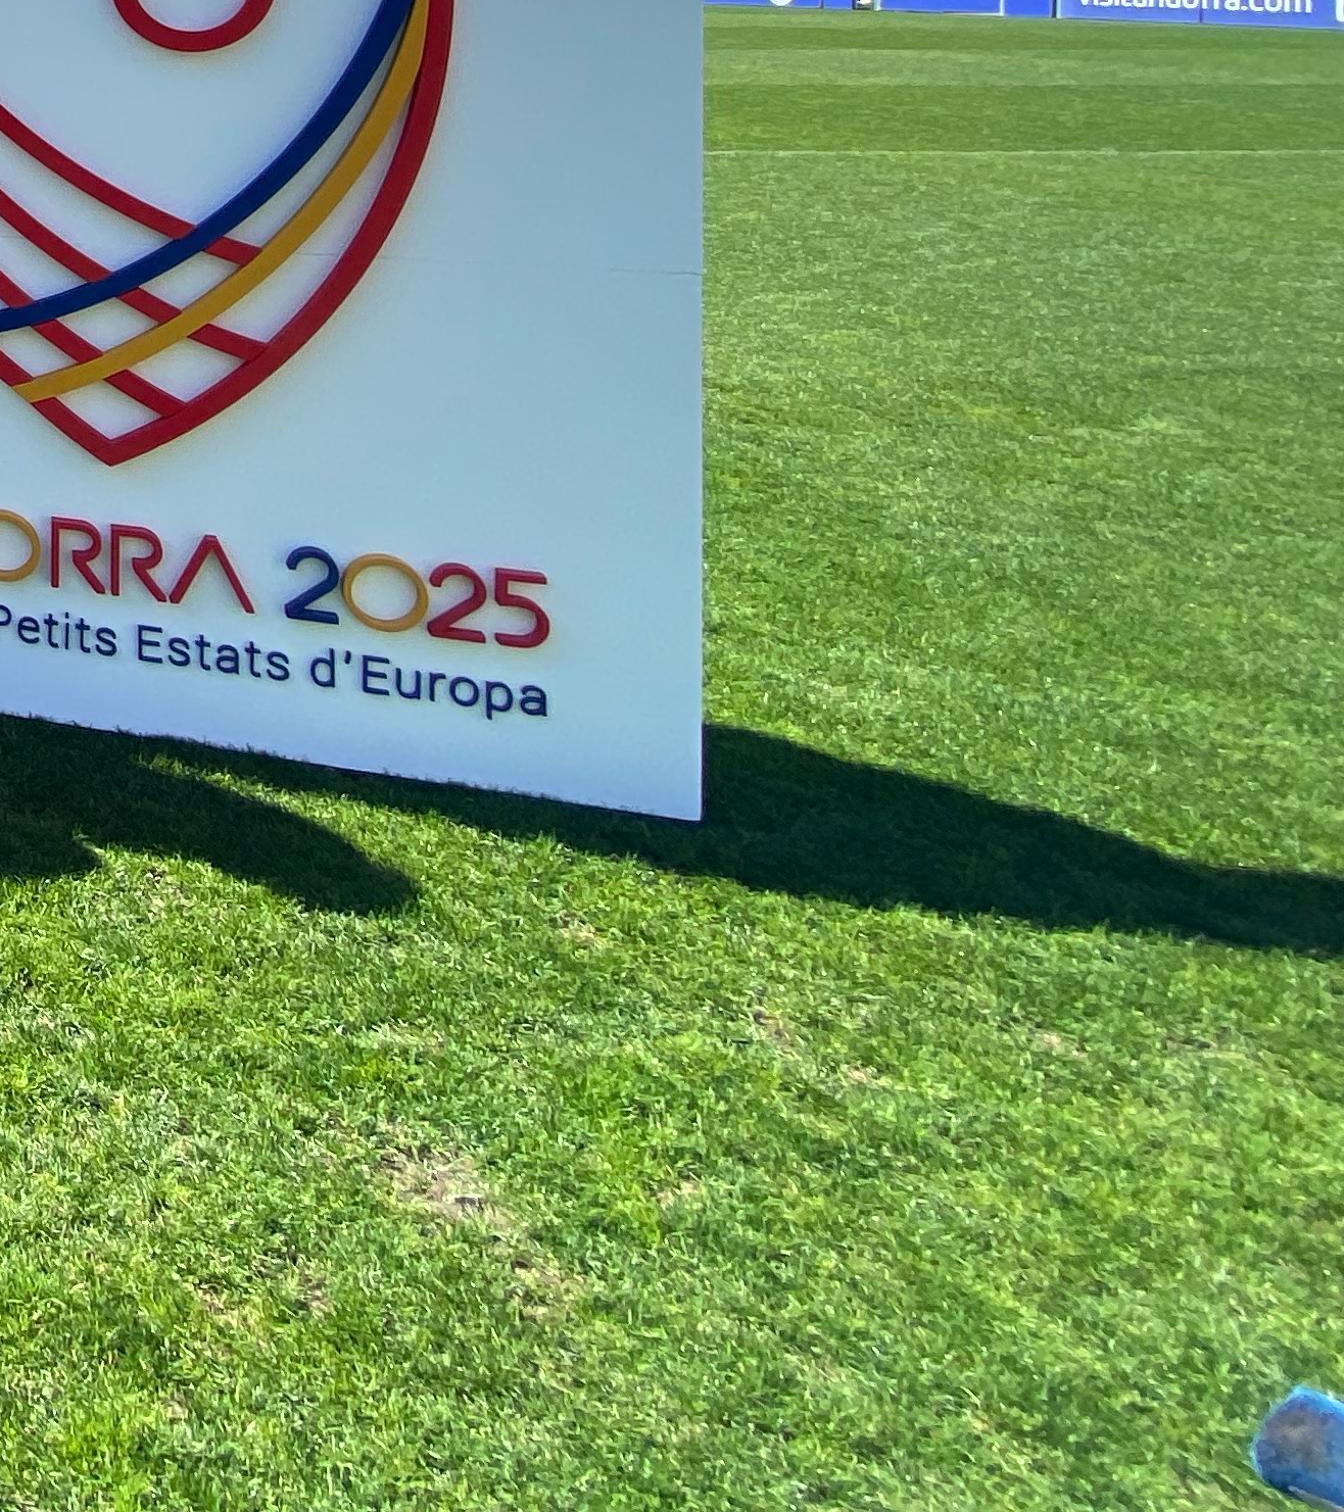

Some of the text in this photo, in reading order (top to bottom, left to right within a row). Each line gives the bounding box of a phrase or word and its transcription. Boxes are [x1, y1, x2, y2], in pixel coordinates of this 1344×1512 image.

[284, 545, 551, 648] 2025
[137, 624, 290, 682] Estats
[310, 648, 548, 720] d'Europa
